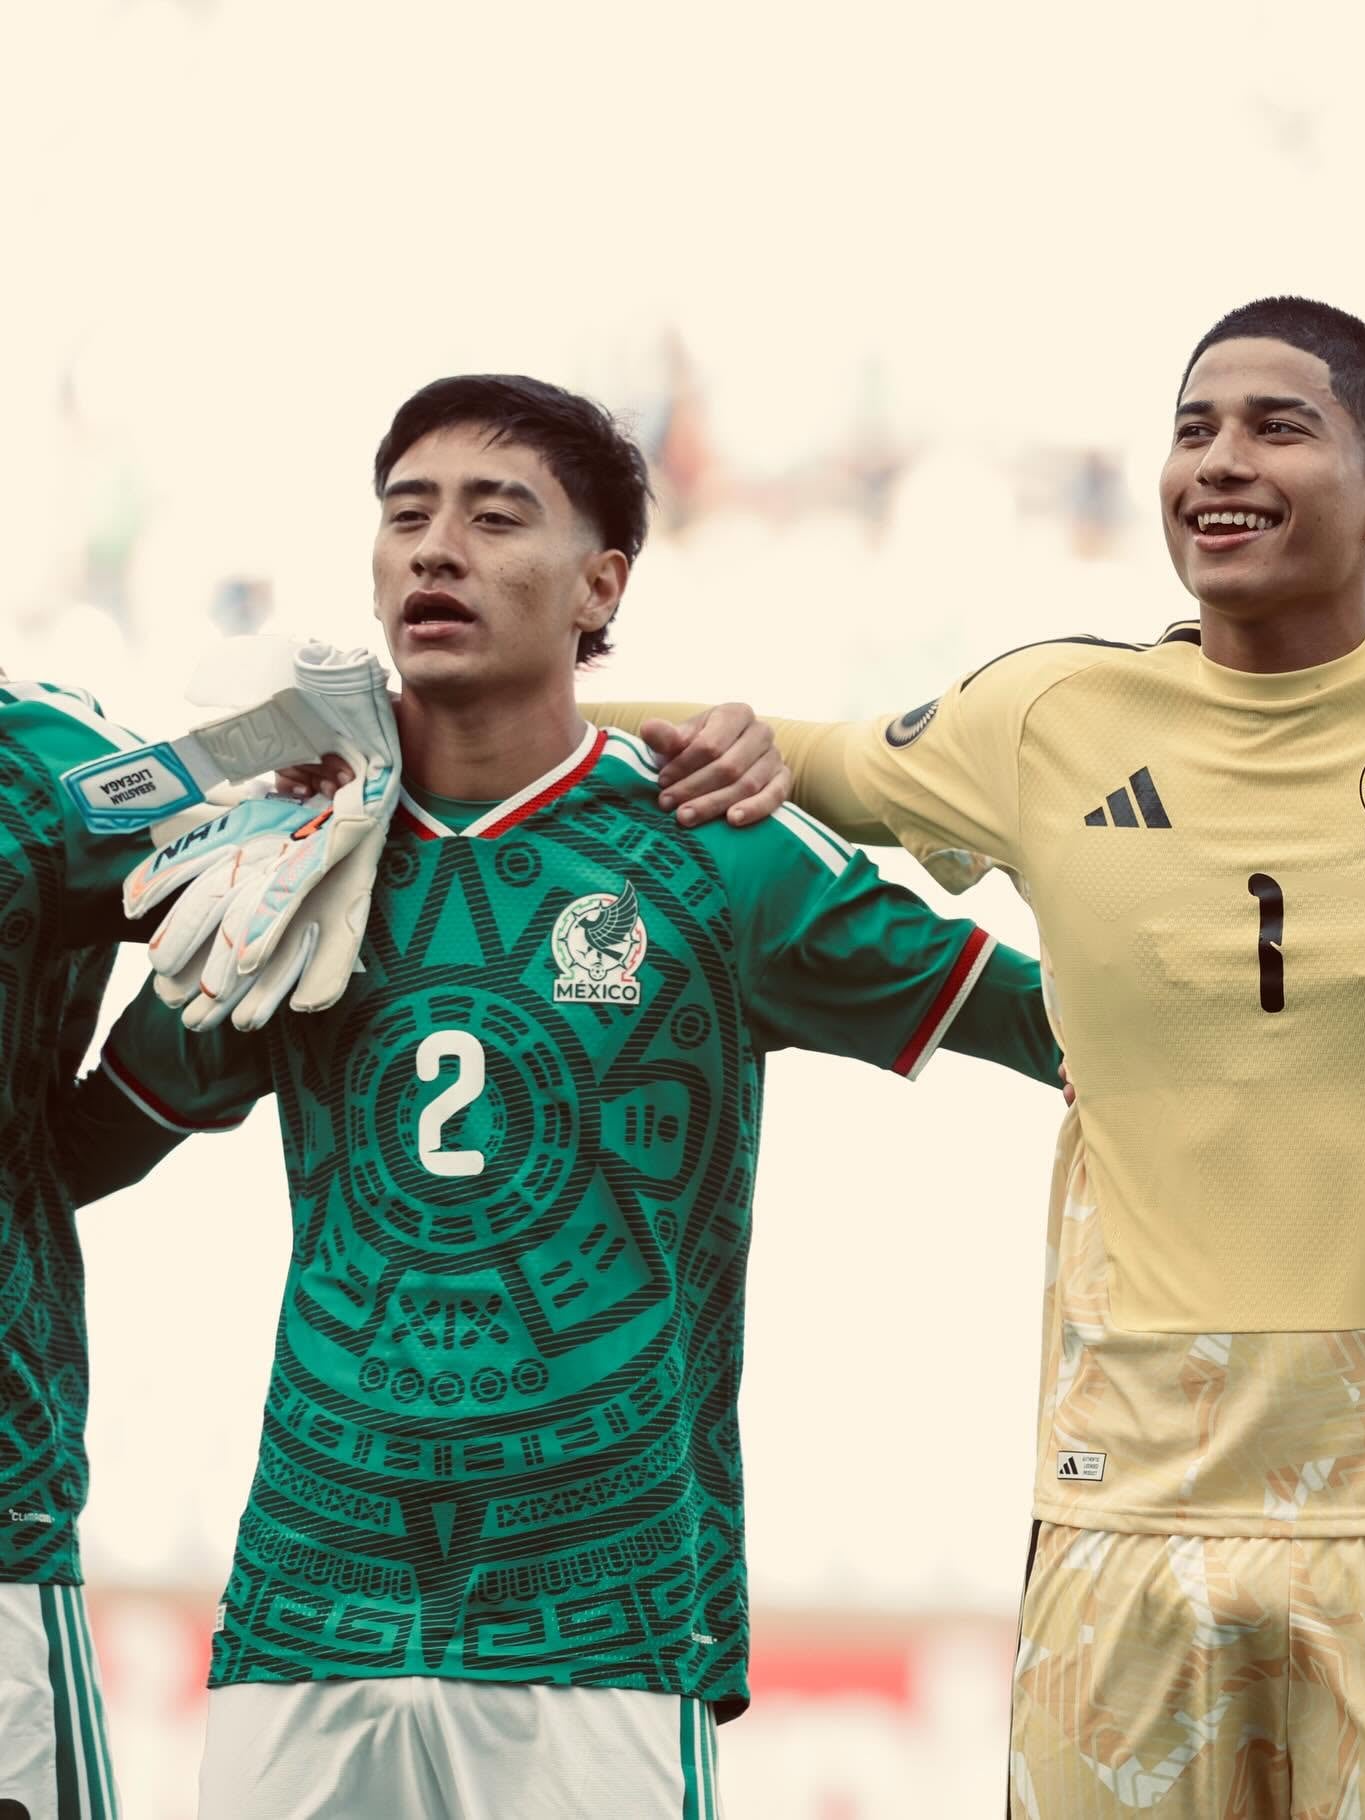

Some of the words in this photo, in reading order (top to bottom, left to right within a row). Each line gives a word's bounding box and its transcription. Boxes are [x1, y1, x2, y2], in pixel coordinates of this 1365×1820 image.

[100, 769, 152, 795] LICEAGA
[110, 781, 156, 805] SEBASTIAN
[1247, 872, 1285, 1013] 1
[556, 979, 638, 1000] MÉXICO
[416, 1029, 486, 1177] 2
